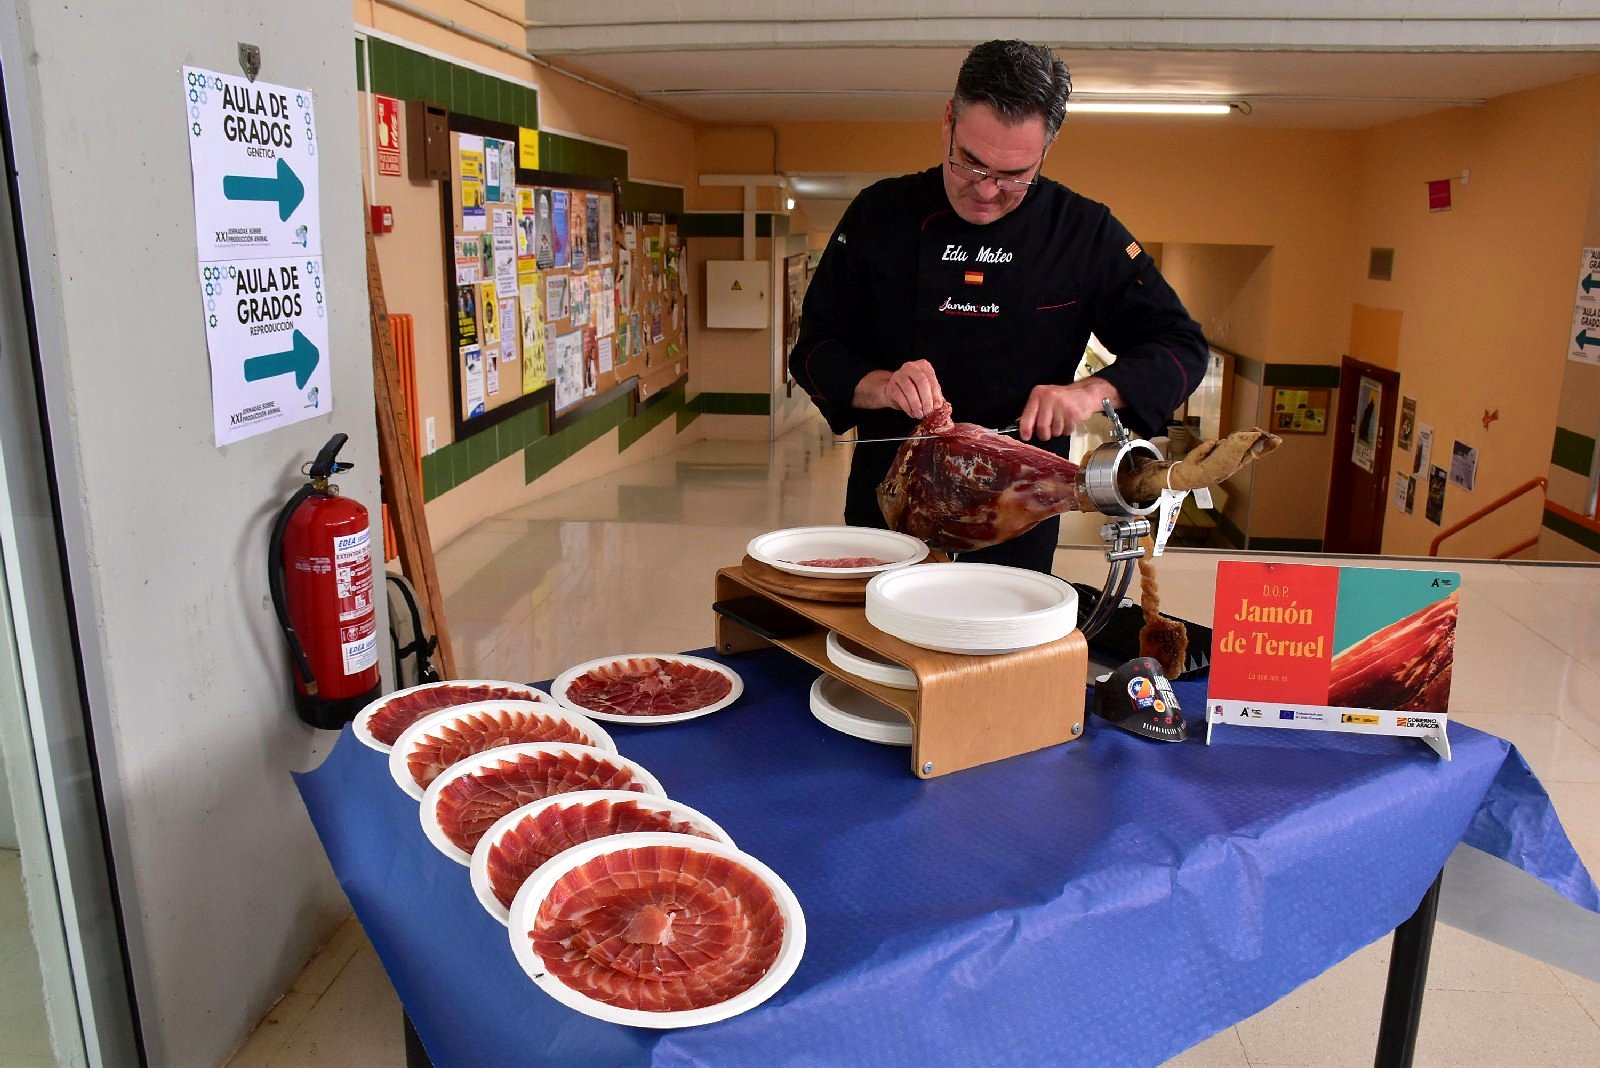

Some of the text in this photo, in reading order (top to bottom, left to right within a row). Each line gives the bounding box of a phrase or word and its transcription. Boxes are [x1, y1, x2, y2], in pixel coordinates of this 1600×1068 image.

[223, 84, 288, 120] AULA DE
[224, 115, 292, 148] GRADOS
[247, 146, 275, 158] GENÉTICA
[215, 231, 228, 242] XXI
[941, 244, 1013, 264] Edu Mateo
[236, 266, 300, 295] AULA DE
[237, 293, 303, 324] GRADOS
[939, 296, 977, 312] Jamón
[250, 318, 294, 336] REPRODUCCIÓN
[230, 412, 243, 425] XXI
[338, 537, 356, 548] EDEA
[337, 549, 361, 560] EXTINTOR
[1263, 584, 1289, 598] D.O.P.
[1234, 598, 1313, 625] Jamón
[349, 643, 365, 655] EDEA
[1220, 630, 1324, 658] de Teruel
